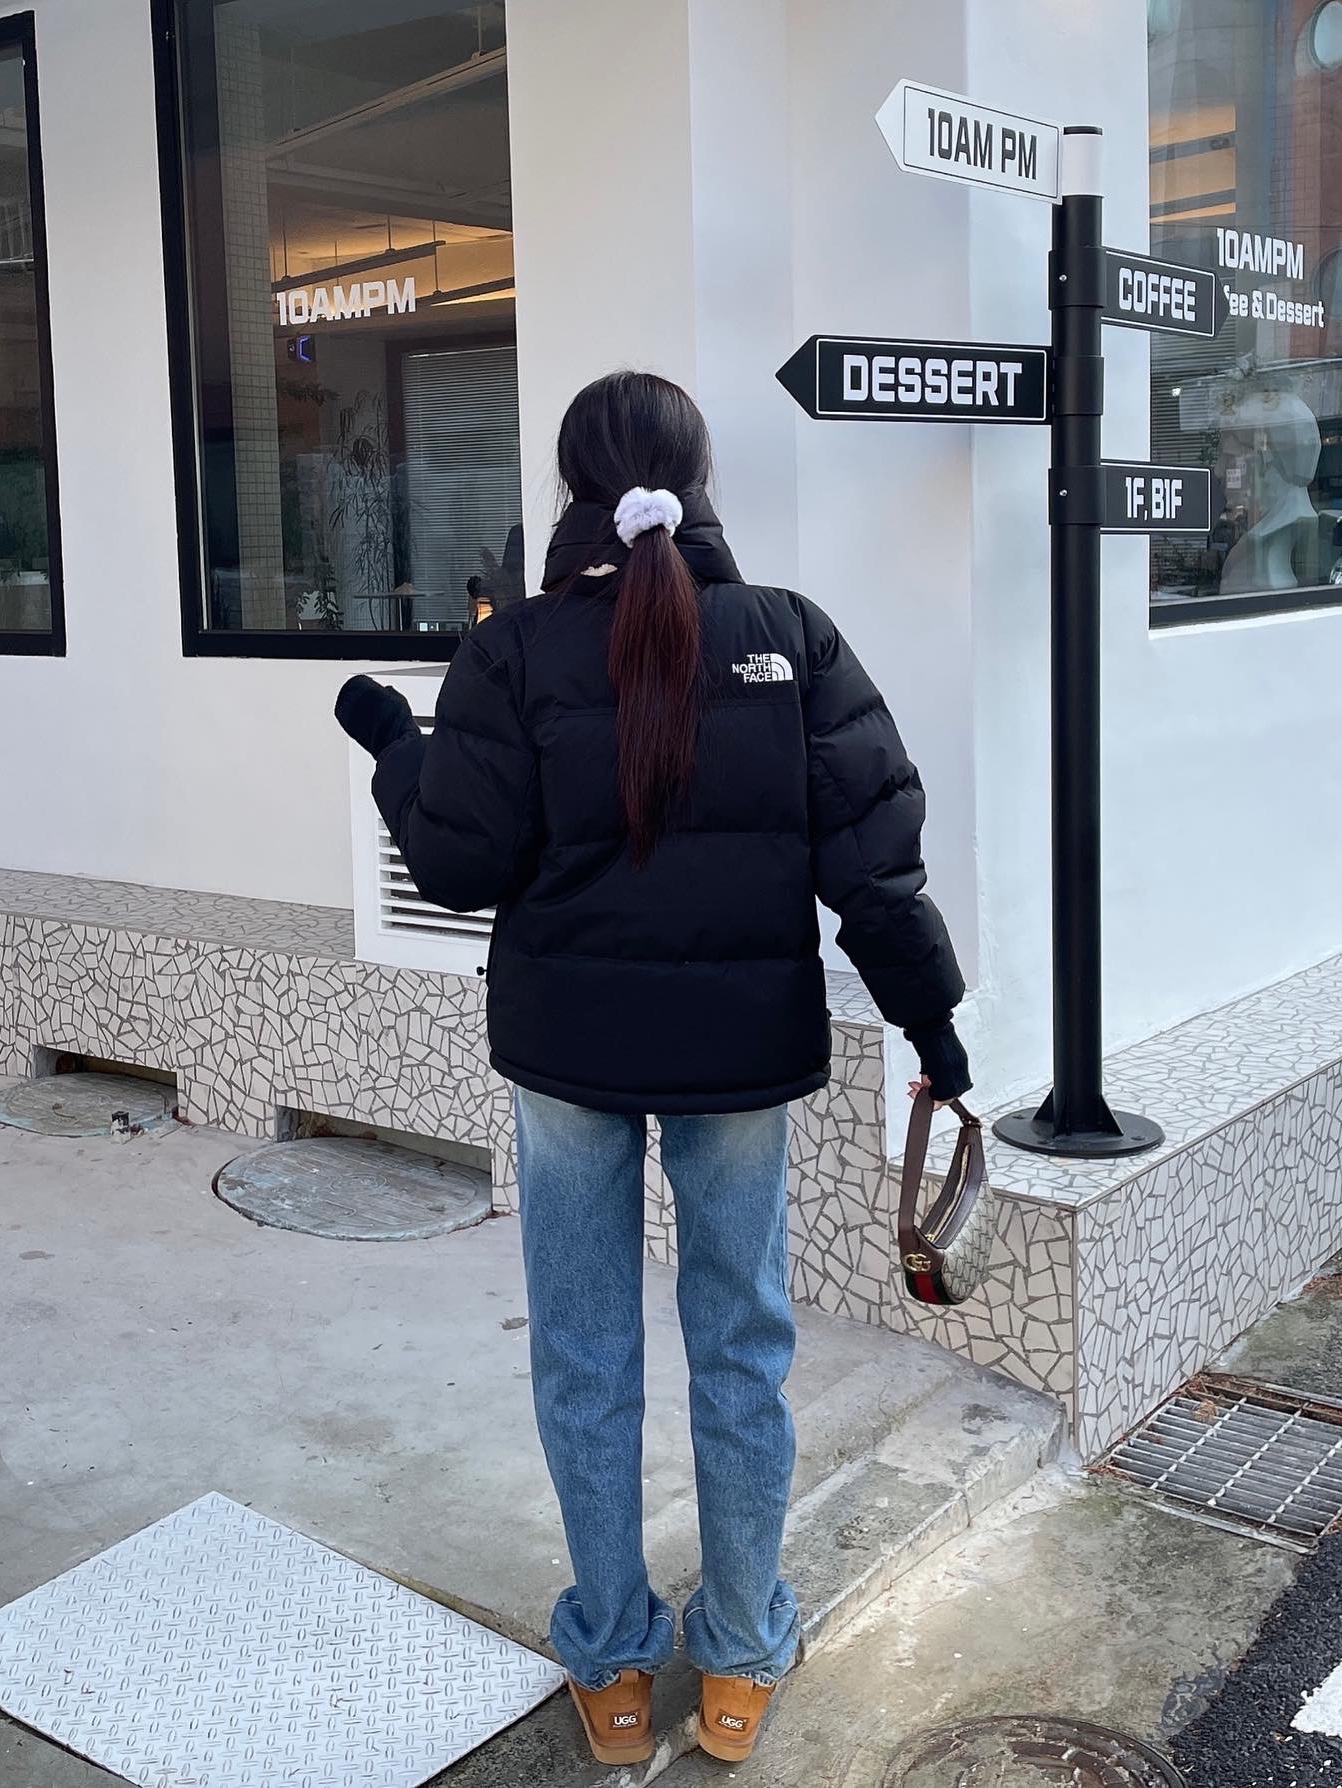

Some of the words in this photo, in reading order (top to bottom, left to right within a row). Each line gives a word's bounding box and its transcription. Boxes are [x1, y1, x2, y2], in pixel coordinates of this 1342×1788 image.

[927, 107, 993, 170] 10AM
[1001, 126, 1037, 180] PM
[1216, 227, 1304, 280] 10AMPM
[276, 277, 416, 326] 10AMPM
[1119, 267, 1196, 322] COFFEE
[1252, 290, 1265, 319] &
[1266, 292, 1325, 328] Dessert
[843, 354, 1023, 407] DESSERT
[1125, 476, 1148, 521] 1F,
[1151, 478, 1183, 519] B1F
[732, 663, 771, 673] NORTH
[743, 673, 772, 683] FACE
[747, 653, 770, 663] THE
[614, 1715, 637, 1725] UGG
[721, 1715, 744, 1728] UGG
